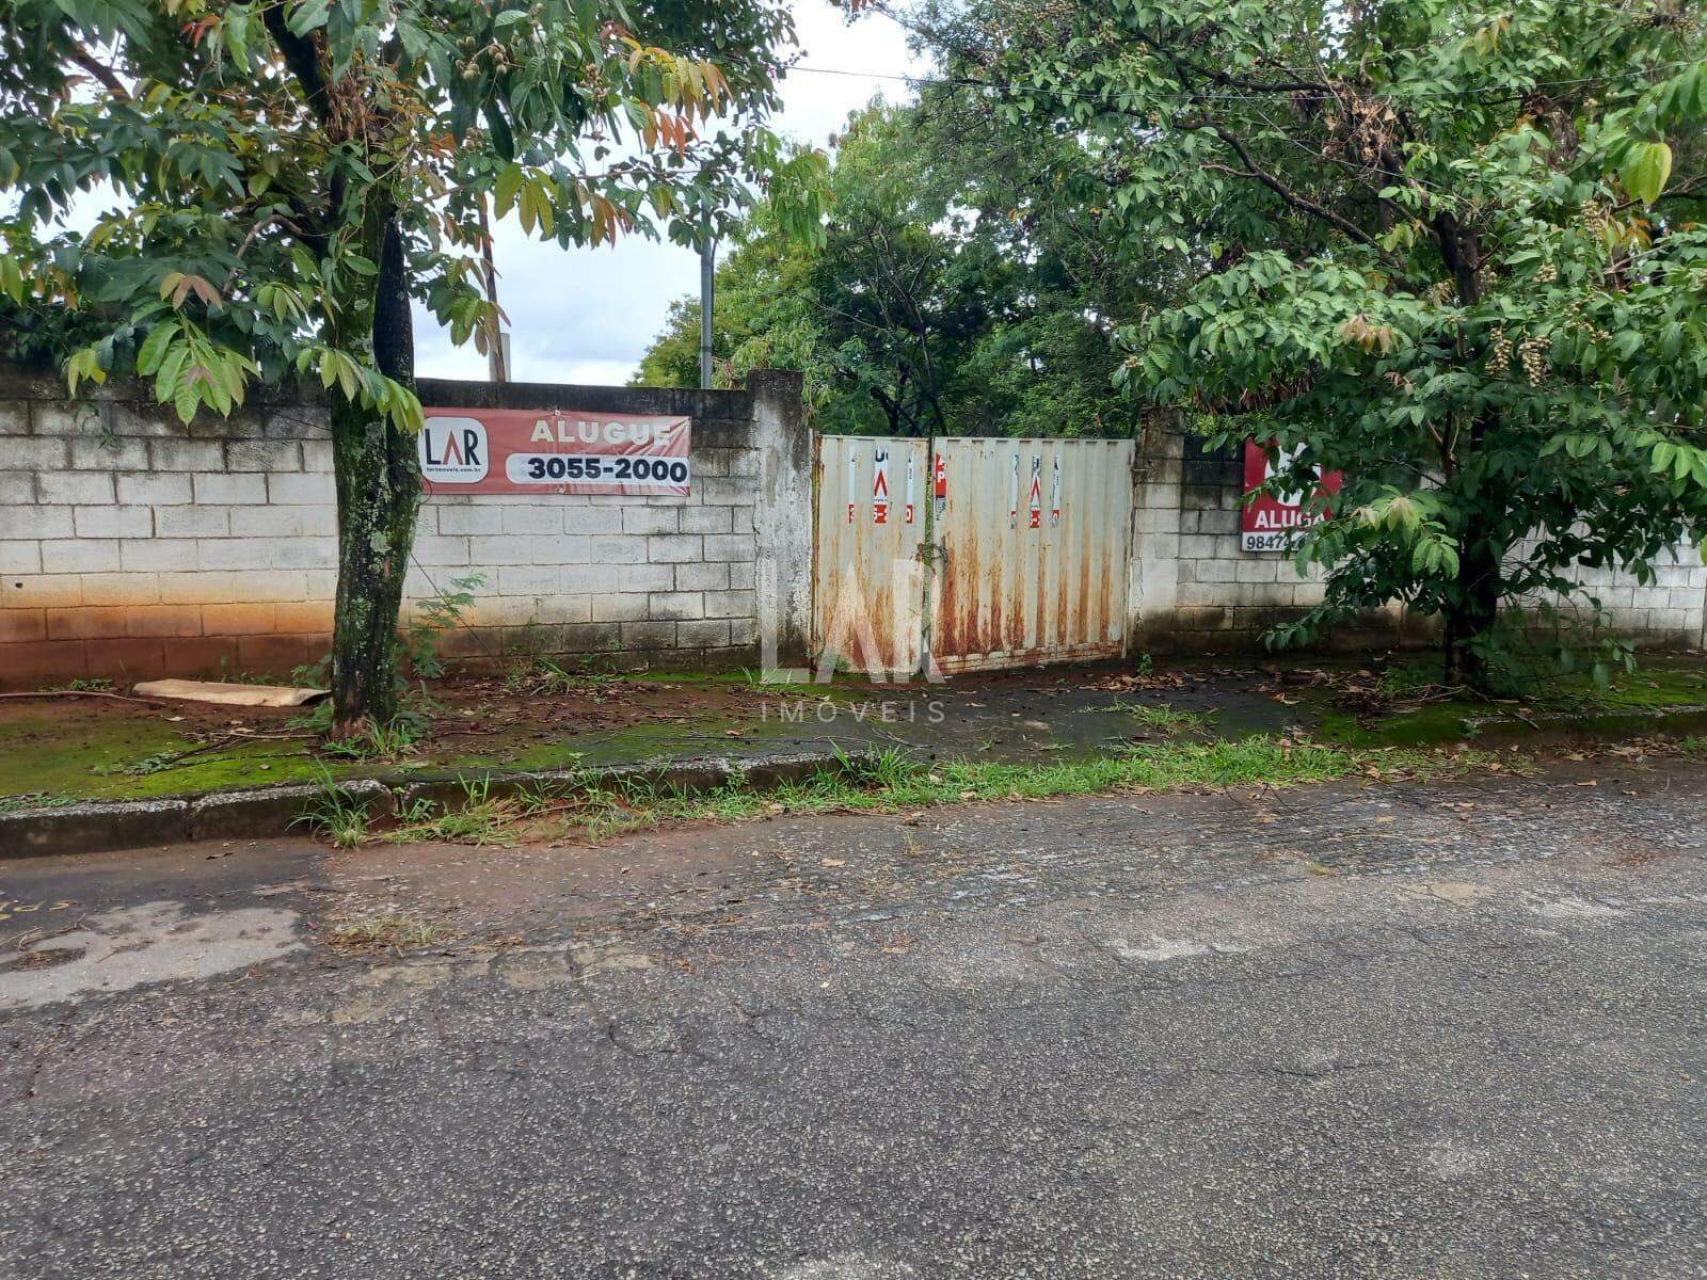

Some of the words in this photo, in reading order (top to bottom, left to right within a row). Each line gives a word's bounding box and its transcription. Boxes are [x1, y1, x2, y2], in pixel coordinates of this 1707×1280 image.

[530, 419, 671, 446] ALUGUE
[425, 428, 481, 465] LAR
[528, 457, 688, 483] 3055-2000
